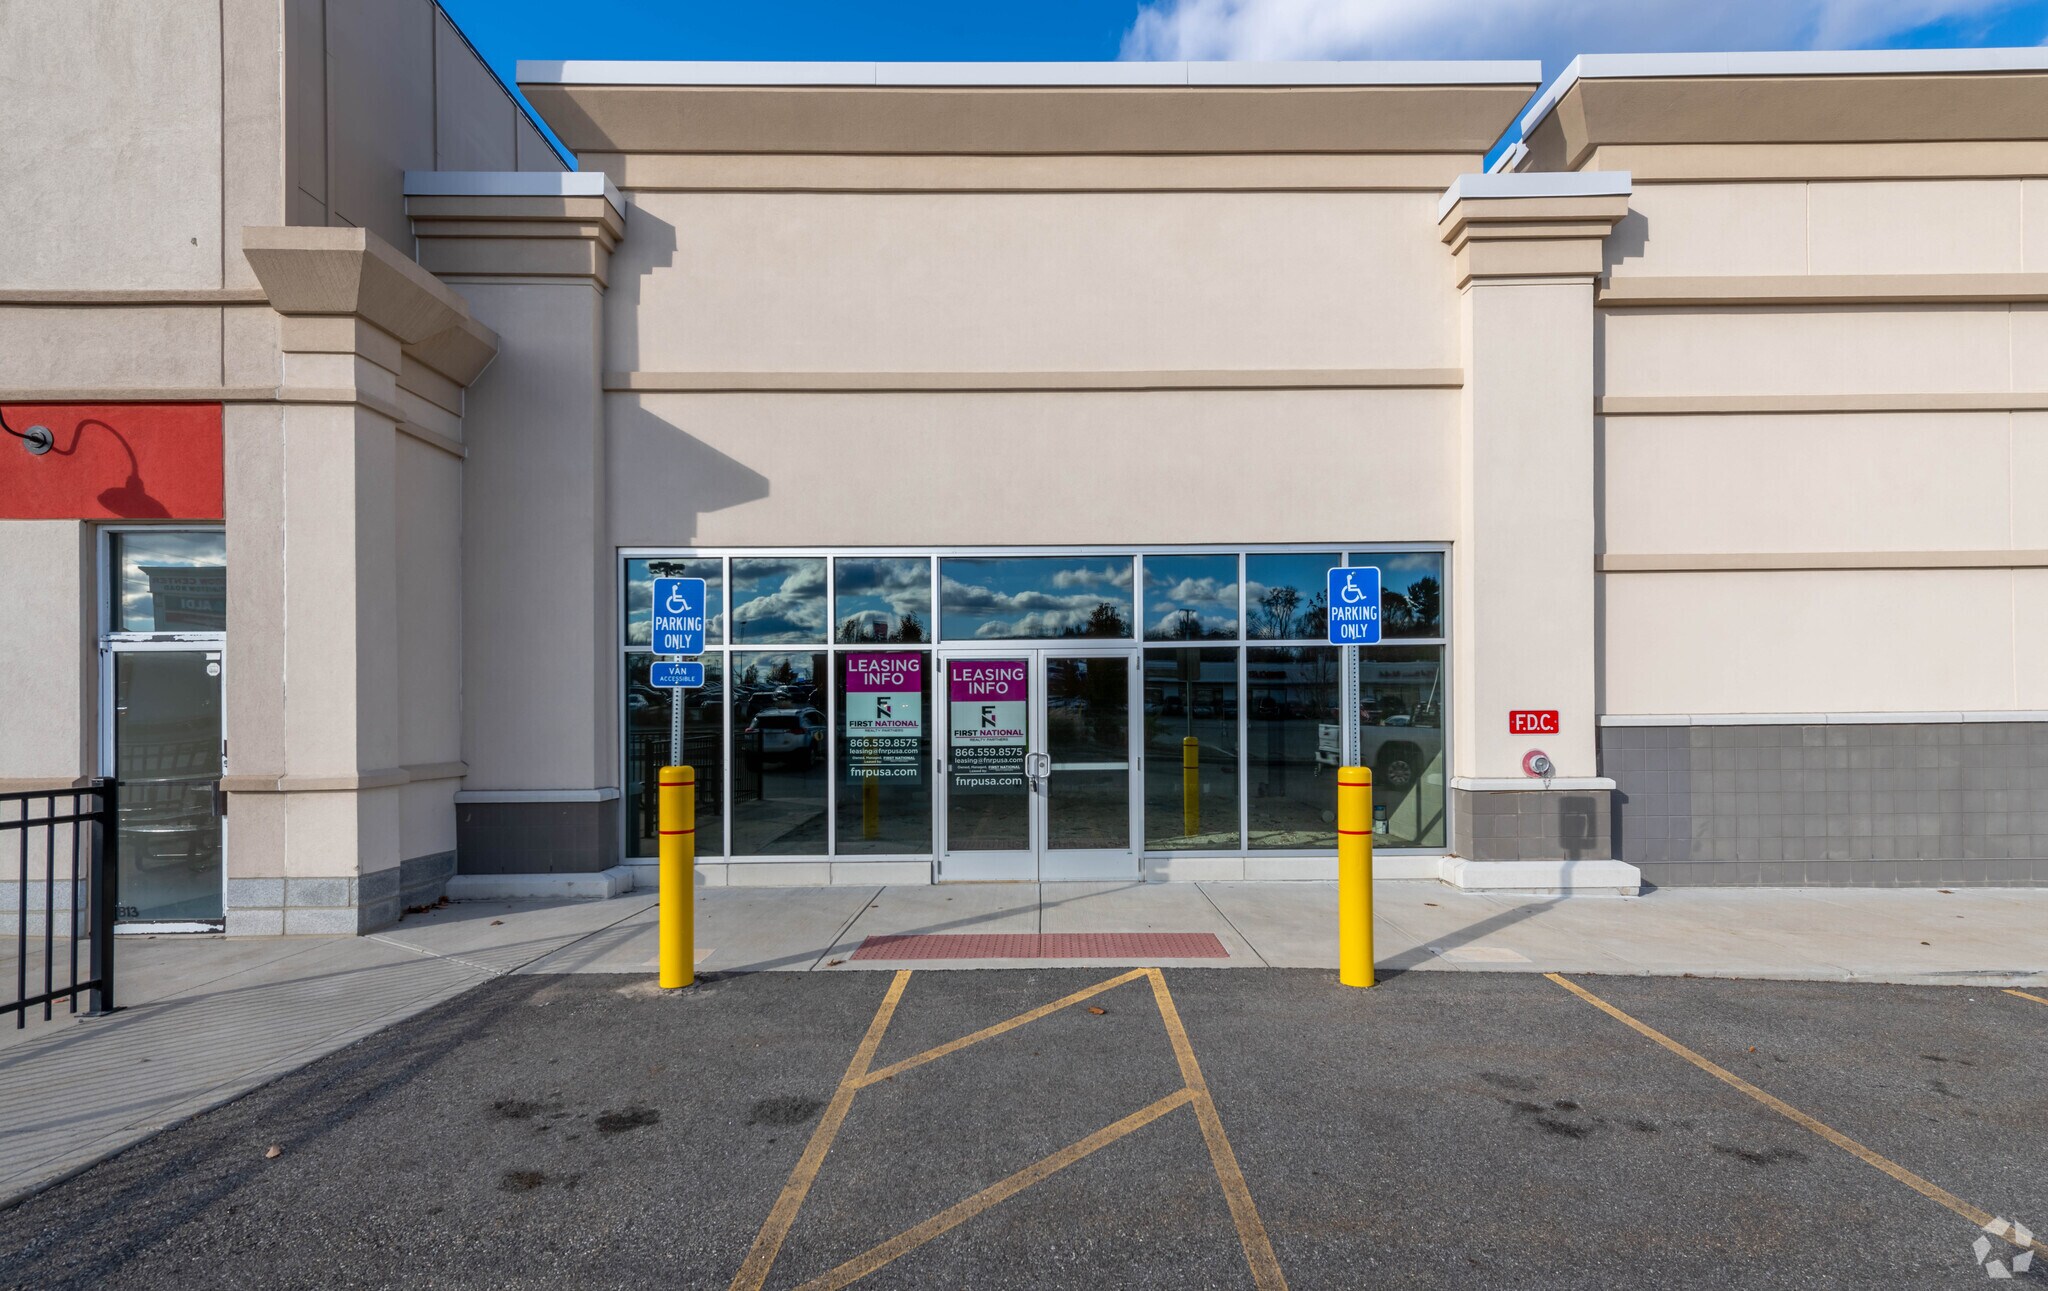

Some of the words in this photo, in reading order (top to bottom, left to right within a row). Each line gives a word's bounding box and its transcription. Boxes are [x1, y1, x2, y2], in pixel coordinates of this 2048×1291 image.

[1331, 606, 1377, 621] PARKING
[655, 616, 702, 631] PARKING
[1341, 623, 1368, 639] ONLY
[664, 634, 692, 649] ONLY
[668, 667, 687, 675] VAN
[848, 659, 920, 672] LEASING
[864, 672, 904, 685] INFO
[953, 668, 1024, 681] LEASING
[968, 681, 1009, 694] INFO
[1515, 713, 1554, 731] F.D.C.
[954, 729, 978, 737] FIRST
[849, 738, 918, 748] 866.559.8575
[849, 748, 919, 756] leasing@fnrpusa.com
[955, 747, 1023, 757] 866.559.8575
[954, 757, 1024, 765] leasing@fnrpusa.com
[850, 767, 917, 778] fnrpusa.com
[956, 776, 1022, 787] fnrpusa.com
